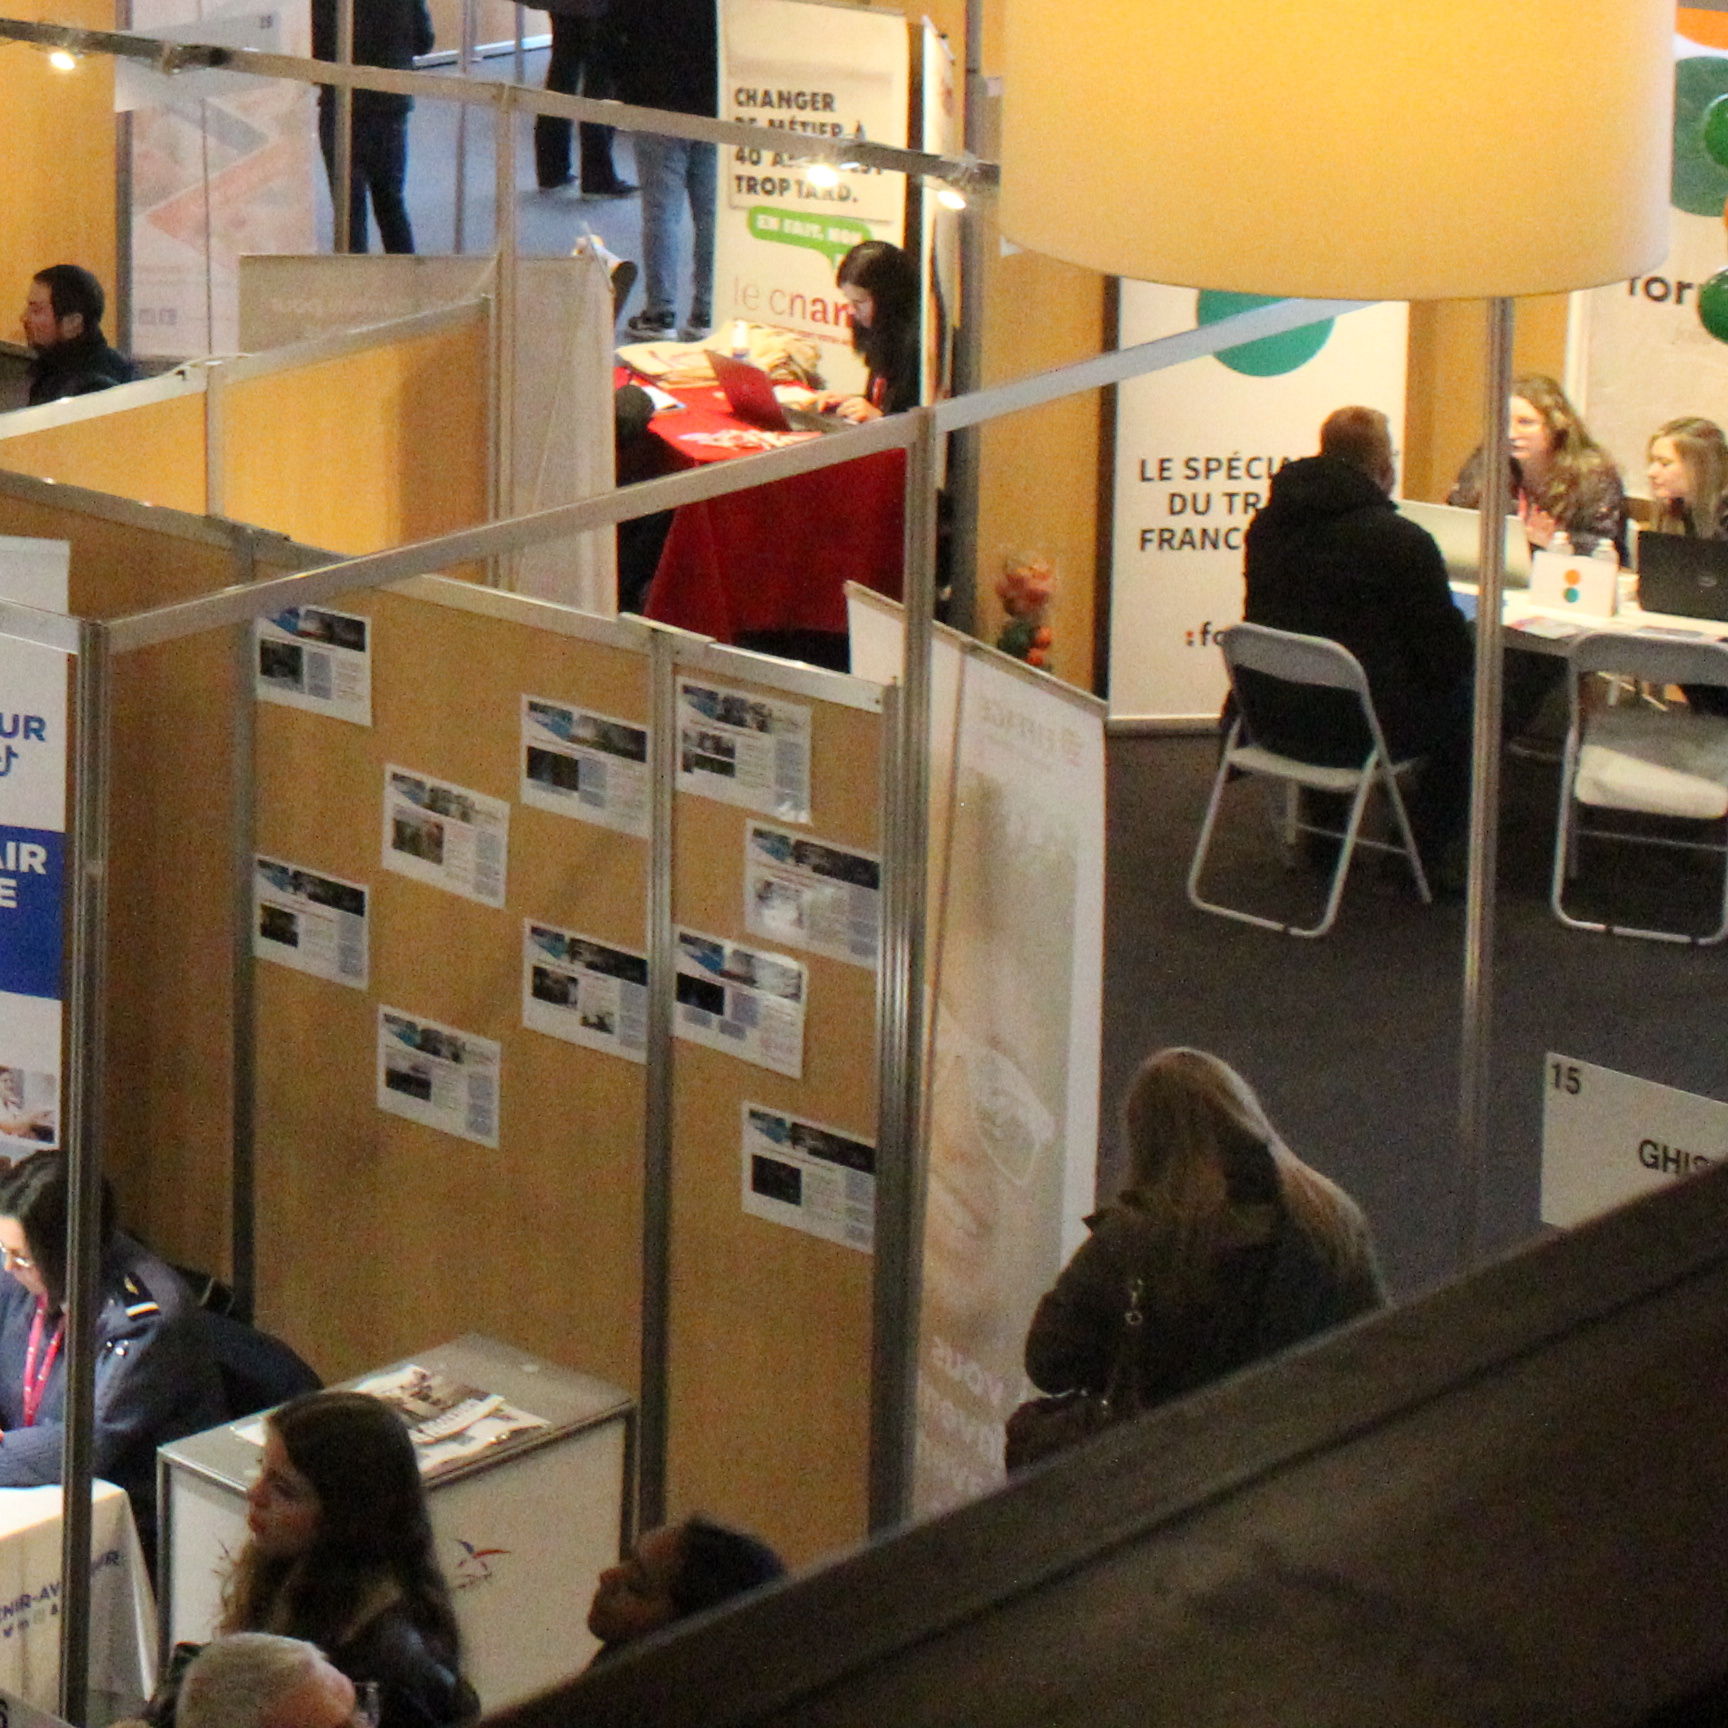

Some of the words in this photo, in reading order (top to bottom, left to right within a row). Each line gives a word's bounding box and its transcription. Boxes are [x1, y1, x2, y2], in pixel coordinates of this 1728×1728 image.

[734, 87, 836, 112] CHANGER
[734, 174, 791, 198] TROP
[734, 274, 760, 311] le
[1139, 458, 1174, 482] LE
[1169, 492, 1211, 516] DU
[1140, 526, 1242, 551] FRANC
[1552, 1062, 1582, 1095] 15
